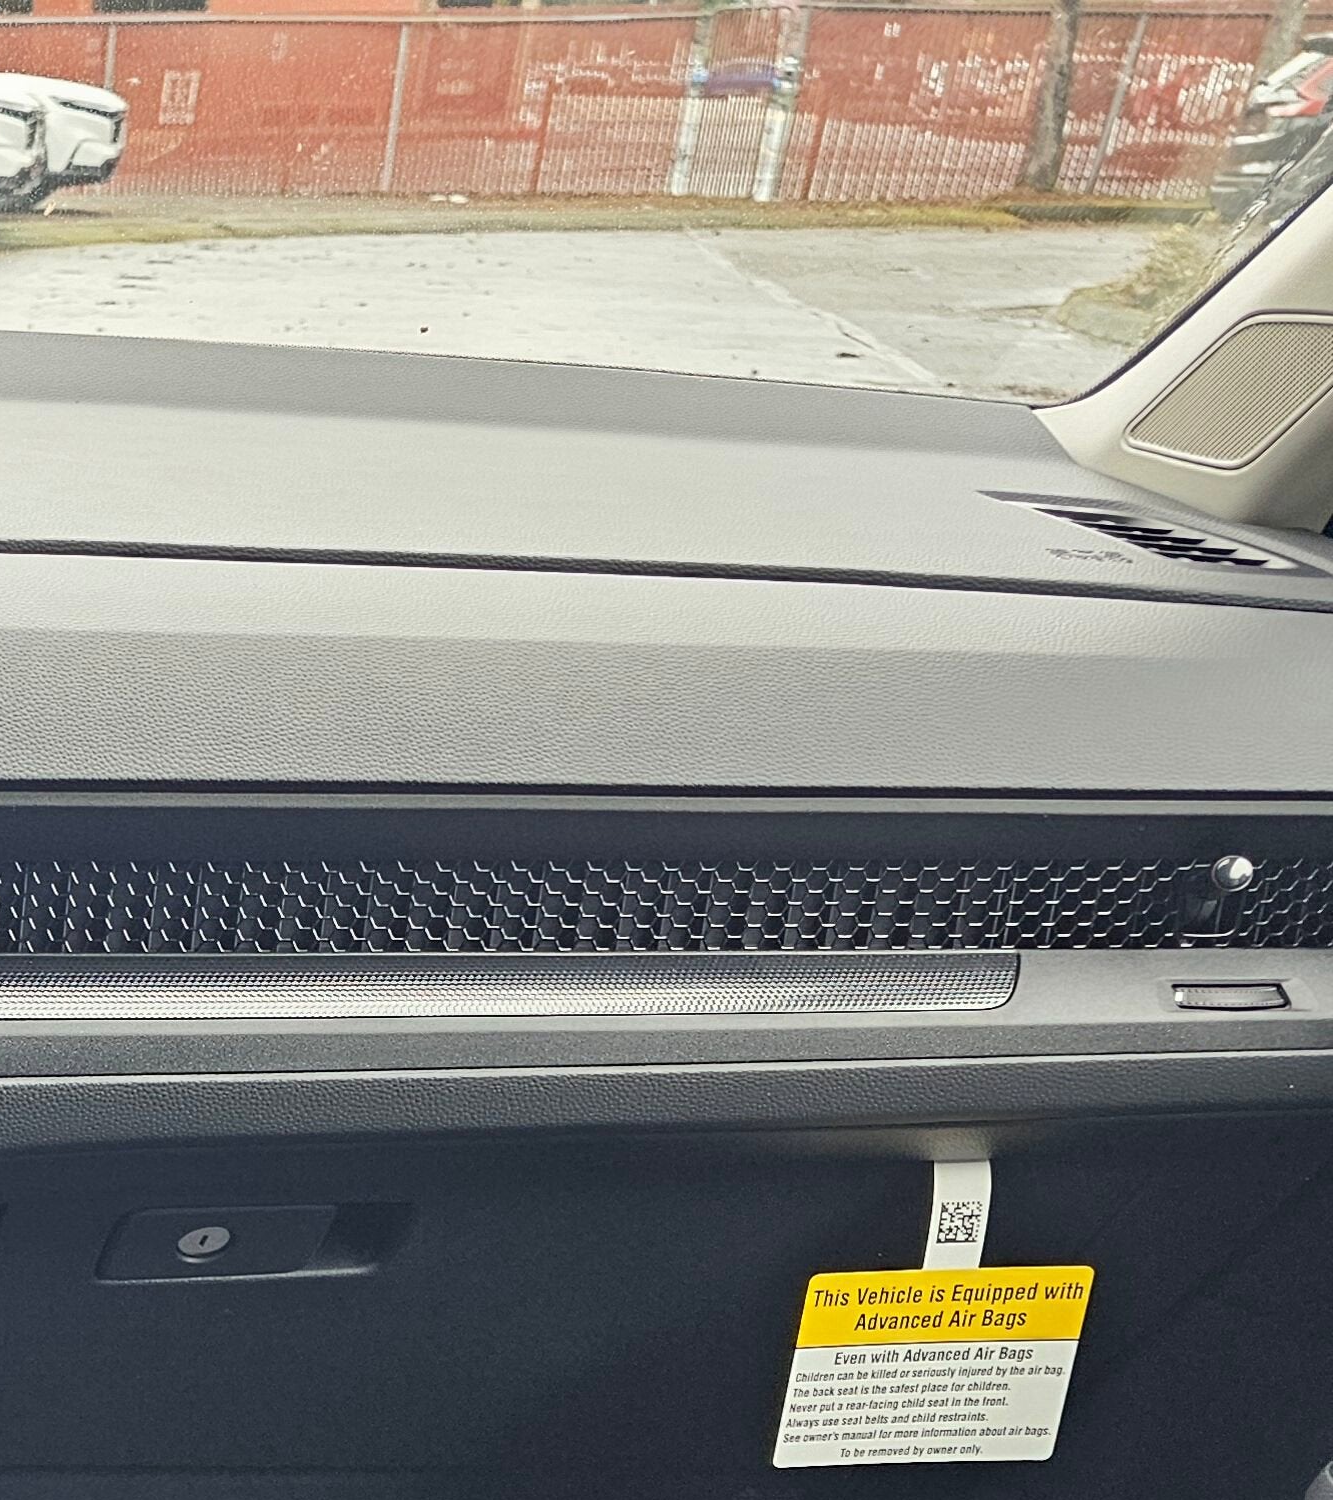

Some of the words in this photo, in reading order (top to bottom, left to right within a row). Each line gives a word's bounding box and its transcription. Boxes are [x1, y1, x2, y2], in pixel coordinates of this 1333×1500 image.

[814, 1288, 849, 1308] This
[857, 1286, 922, 1305] Vehicle
[929, 1285, 945, 1303] is
[951, 1283, 1038, 1305] Equipped
[1045, 1282, 1083, 1300] with
[854, 1311, 943, 1331] Advanced
[948, 1310, 977, 1328] Air
[982, 1309, 1027, 1330] Bags
[834, 1352, 866, 1365] Even
[871, 1350, 899, 1364] with
[903, 1347, 971, 1362] Advanced
[973, 1347, 995, 1360] Air
[999, 1347, 1034, 1362] Bags
[795, 1372, 834, 1382] Children
[837, 1373, 854, 1381] can
[857, 1370, 868, 1380] be
[871, 1369, 898, 1379] killed
[900, 1370, 910, 1378] or
[912, 1366, 955, 1378] seriously
[958, 1366, 994, 1378] injured
[995, 1366, 1008, 1377] by
[1010, 1365, 1025, 1375] the
[1027, 1365, 1043, 1375] air
[1044, 1364, 1065, 1377] bag.
[793, 1388, 809, 1398] The
[812, 1387, 834, 1397] back
[837, 1386, 858, 1396] seat
[861, 1386, 870, 1395] is
[872, 1384, 887, 1394] the
[890, 1383, 919, 1394] safest
[921, 1383, 948, 1394] place
[950, 1382, 965, 1392] for
[967, 1381, 1011, 1391] children.
[789, 1403, 817, 1413] Never
[819, 1402, 835, 1413] put
[837, 1403, 843, 1411] a
[846, 1400, 898, 1411] rear-facing
[901, 1398, 925, 1408] child
[927, 1398, 948, 1407] seat
[951, 1398, 961, 1407] in
[964, 1397, 979, 1407] the
[982, 1396, 1008, 1406] front.
[785, 1418, 819, 1429] Always
[822, 1418, 839, 1426] use
[841, 1415, 862, 1425] seat
[864, 1414, 889, 1425] belts
[890, 1414, 910, 1424] and
[912, 1412, 936, 1422] child
[938, 1412, 988, 1422] restraints.
[783, 1433, 801, 1443] See
[803, 1431, 839, 1442] owner's
[842, 1430, 876, 1440] manual
[879, 1429, 892, 1439] for
[894, 1430, 918, 1438] more
[921, 1427, 977, 1437] information
[979, 1426, 1007, 1436] about
[1008, 1426, 1023, 1436] air
[1024, 1426, 1051, 1437] bags.
[840, 1448, 851, 1457] To
[853, 1448, 865, 1457] be
[867, 1446, 910, 1456] removed
[913, 1446, 924, 1457] by
[927, 1446, 957, 1454] owner
[960, 1444, 983, 1456] only.
